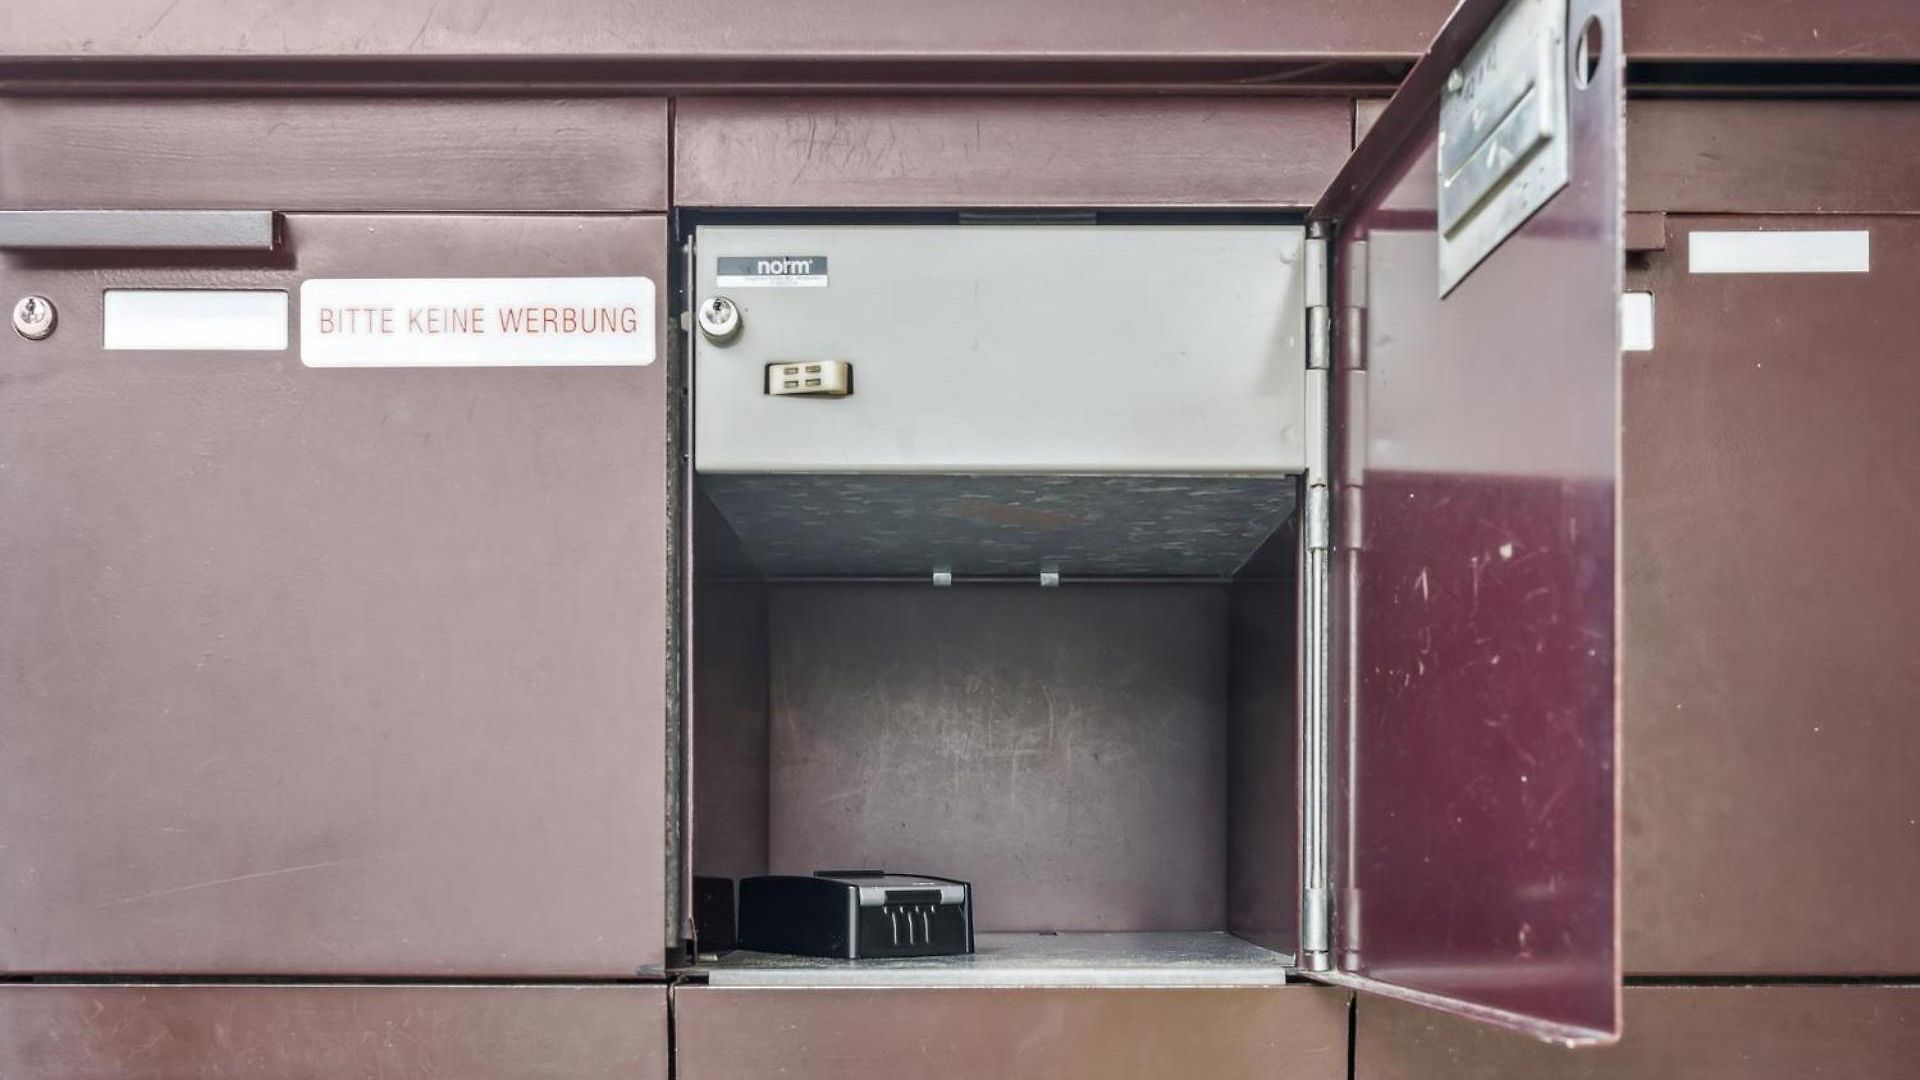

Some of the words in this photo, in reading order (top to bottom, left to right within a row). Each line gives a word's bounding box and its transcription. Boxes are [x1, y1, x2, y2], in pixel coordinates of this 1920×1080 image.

[757, 259, 810, 274] norm
[318, 308, 394, 333] BITTE
[407, 307, 484, 333] KEINE
[498, 307, 639, 333] WERBUNG
